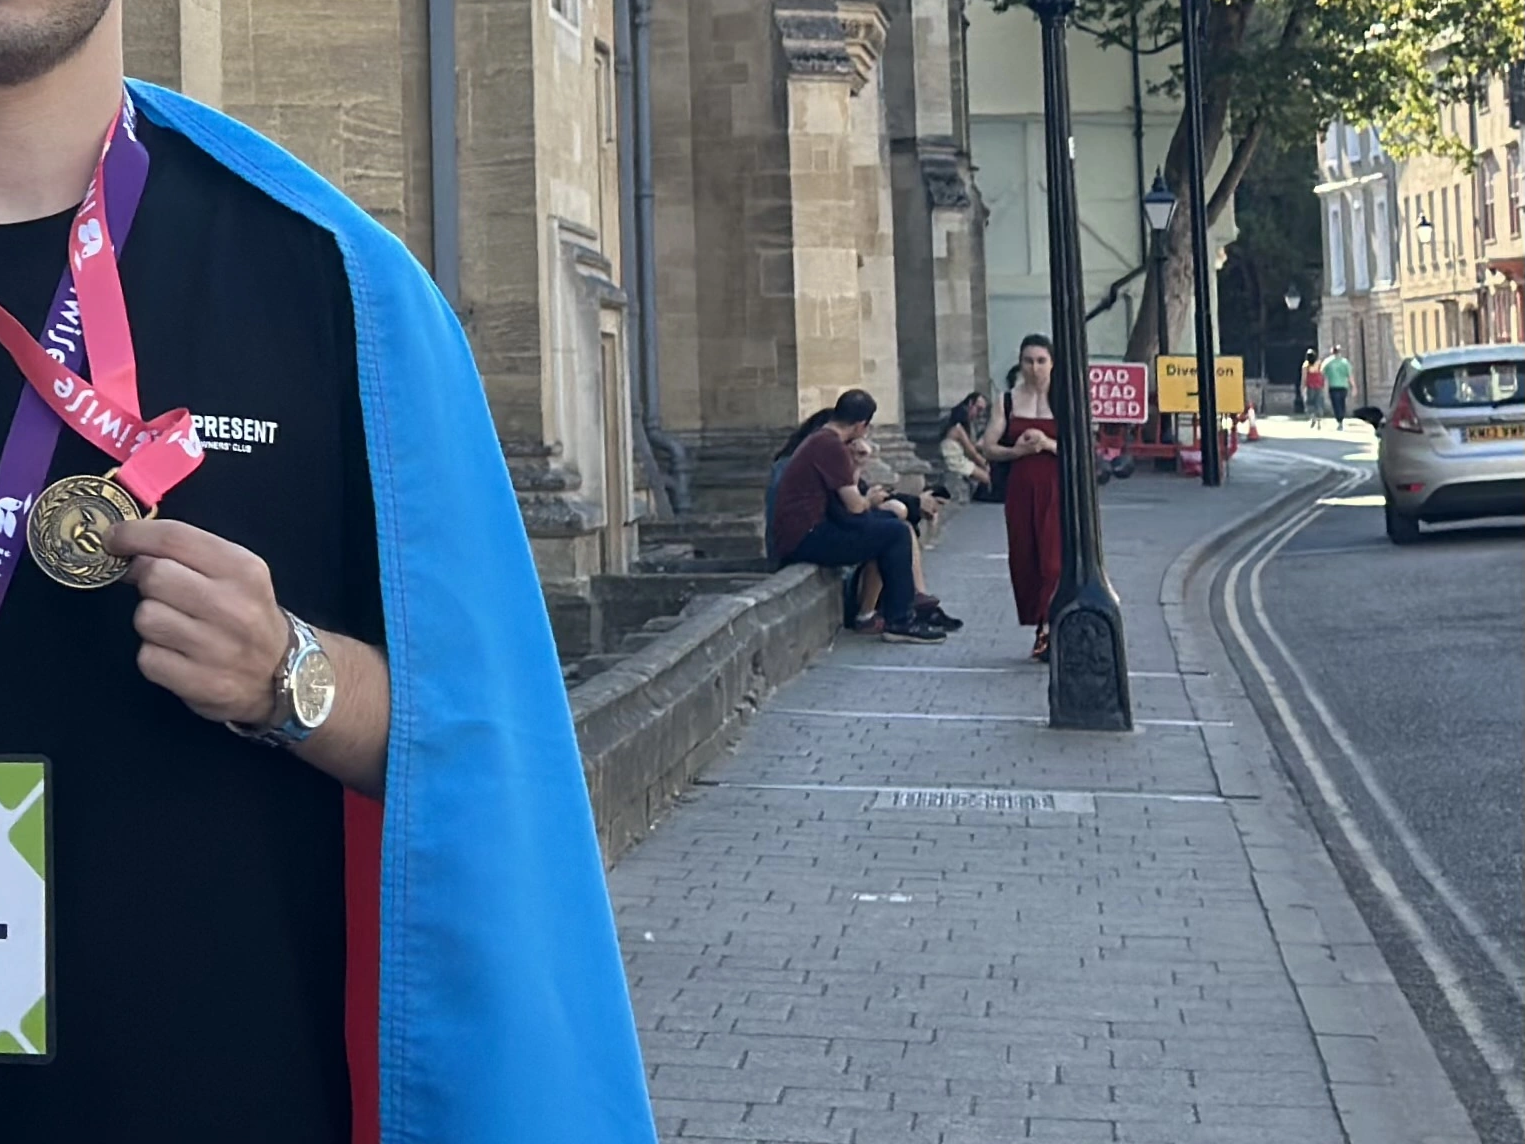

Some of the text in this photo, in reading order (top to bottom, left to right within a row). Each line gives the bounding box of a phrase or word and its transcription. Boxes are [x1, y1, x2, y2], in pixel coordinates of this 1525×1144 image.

[1089, 368, 1129, 383] OAD
[1091, 401, 1140, 416] OSED
[232, 443, 252, 453] CLUB
